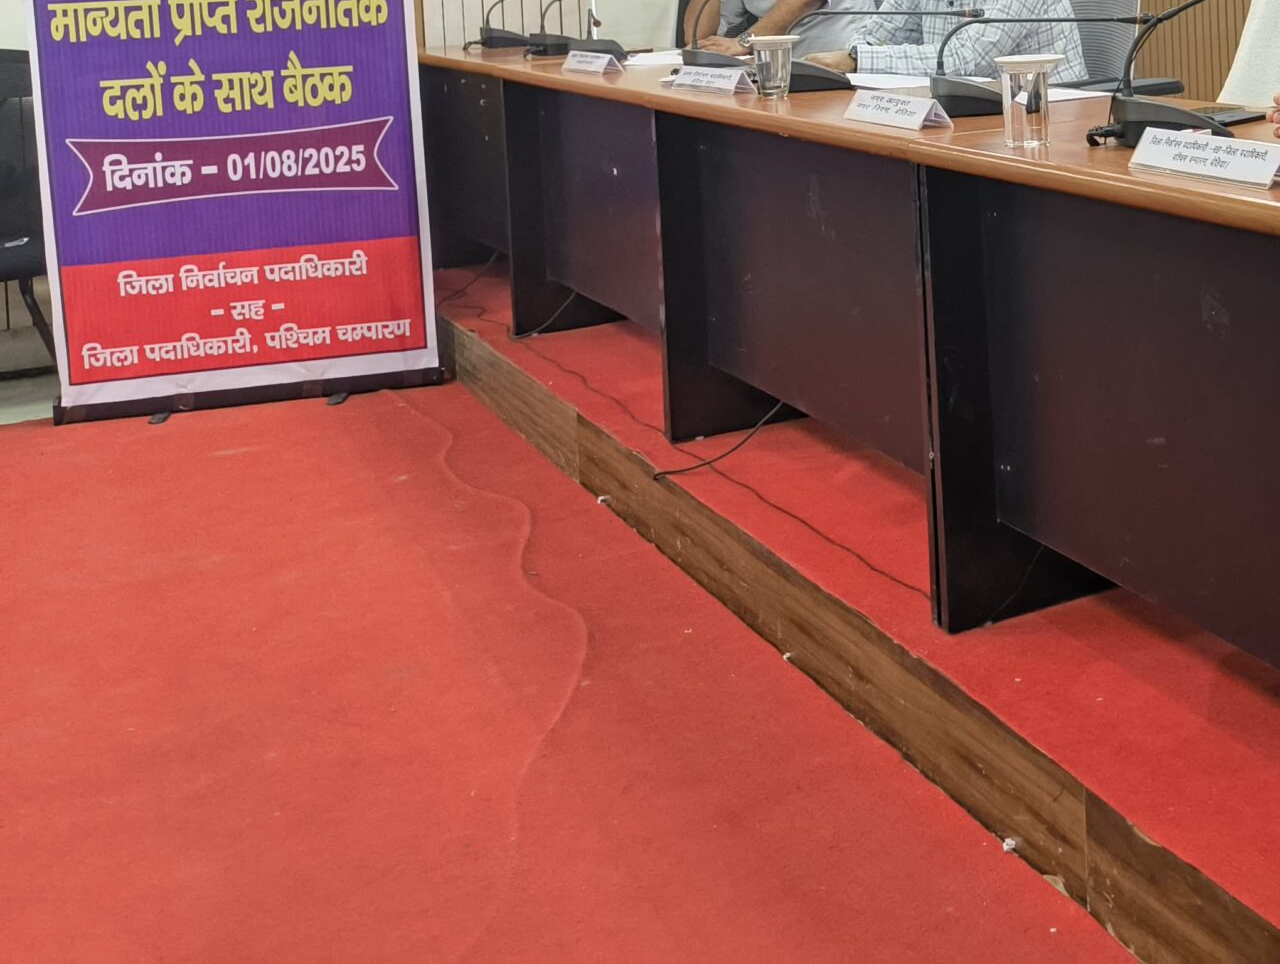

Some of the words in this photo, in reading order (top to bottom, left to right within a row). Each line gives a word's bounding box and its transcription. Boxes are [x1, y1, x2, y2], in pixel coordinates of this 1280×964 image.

[99, 61, 167, 121] दलों
[170, 58, 205, 115] के
[212, 68, 275, 113] साथ
[280, 50, 354, 109] बैठक
[102, 152, 194, 192] दिनांक
[226, 144, 367, 182] 01/08/2025
[117, 270, 174, 297] जिला
[179, 261, 260, 292] निर्वाचन
[264, 249, 368, 284] पदाधिकारी
[230, 299, 266, 320] सह
[81, 342, 140, 370] जिला
[145, 328, 259, 363] पदाधिकारी,
[264, 323, 332, 351] पश्चिम
[336, 318, 412, 343] चम्पारण
